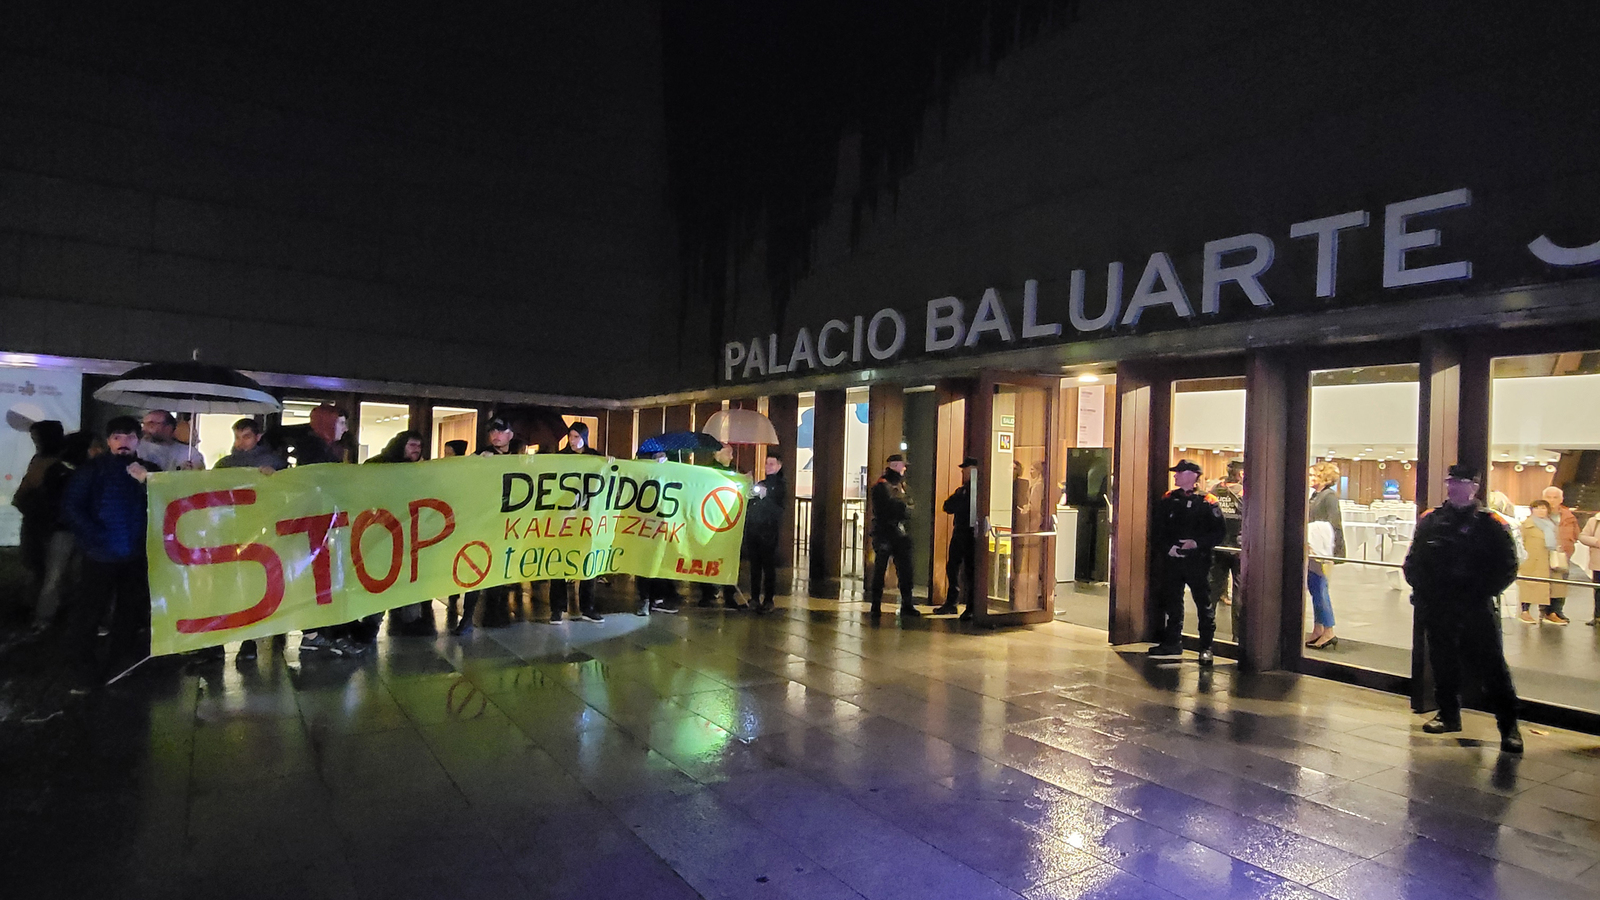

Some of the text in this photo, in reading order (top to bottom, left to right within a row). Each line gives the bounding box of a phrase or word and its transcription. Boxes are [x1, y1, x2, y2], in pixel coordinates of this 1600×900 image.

[724, 187, 1473, 382] PALACIO BALUARTE
[500, 465, 684, 518] DESPIDOS
[503, 515, 687, 543] KALERATZEAK
[163, 488, 456, 634] STOP
[503, 545, 625, 579] telesonic
[677, 558, 721, 577] LAB
